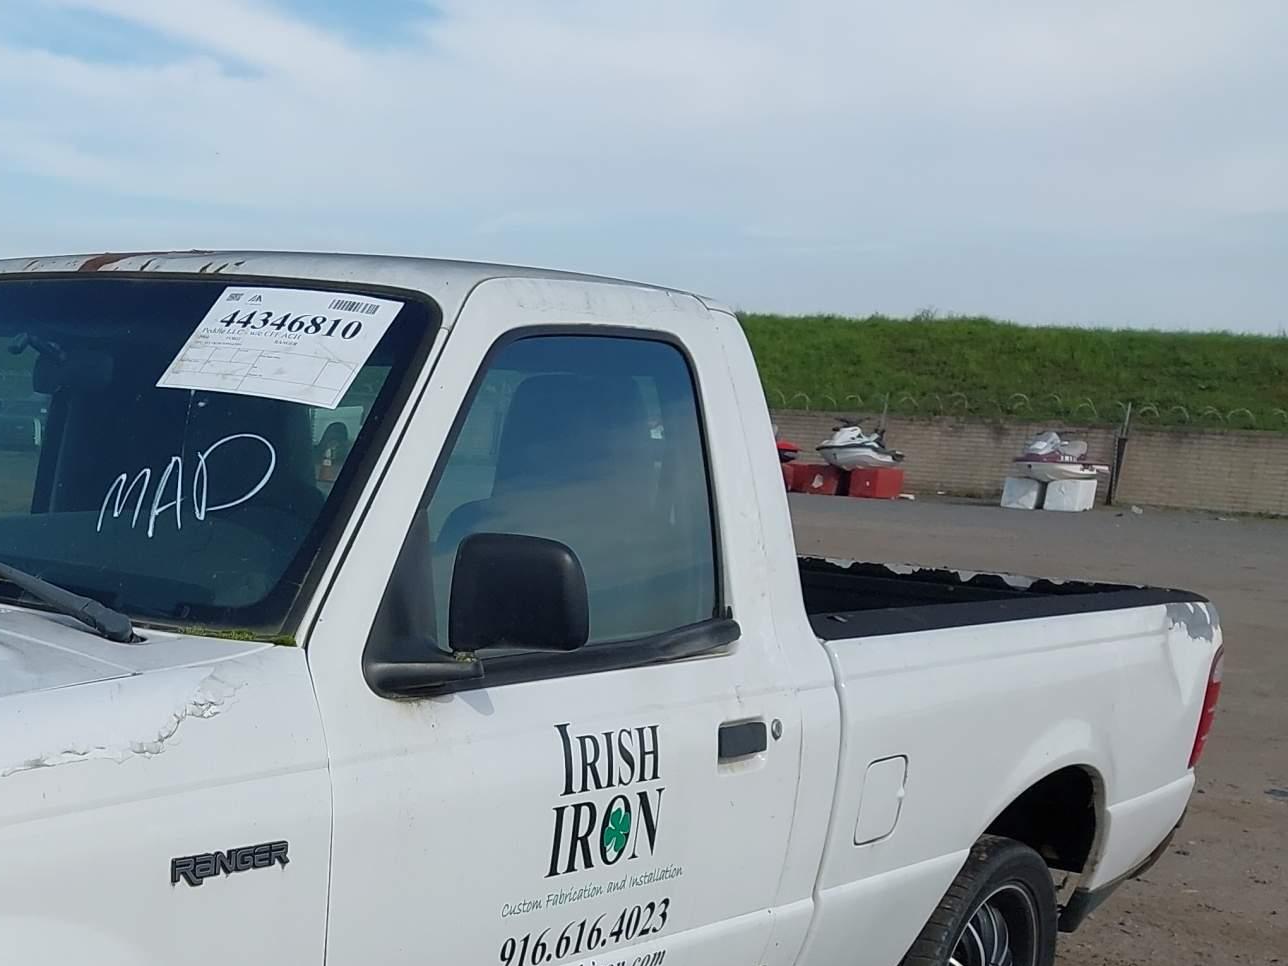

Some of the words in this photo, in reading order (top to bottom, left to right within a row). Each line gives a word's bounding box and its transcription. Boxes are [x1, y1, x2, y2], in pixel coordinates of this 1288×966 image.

[220, 309, 363, 340] 44346810
[554, 722, 661, 797] IRISH
[544, 787, 665, 879] IRON
[171, 840, 290, 887] RANGER
[501, 895, 542, 918] Custom
[546, 882, 604, 908] Fabrication
[607, 874, 627, 893] and
[629, 864, 683, 889] Installation
